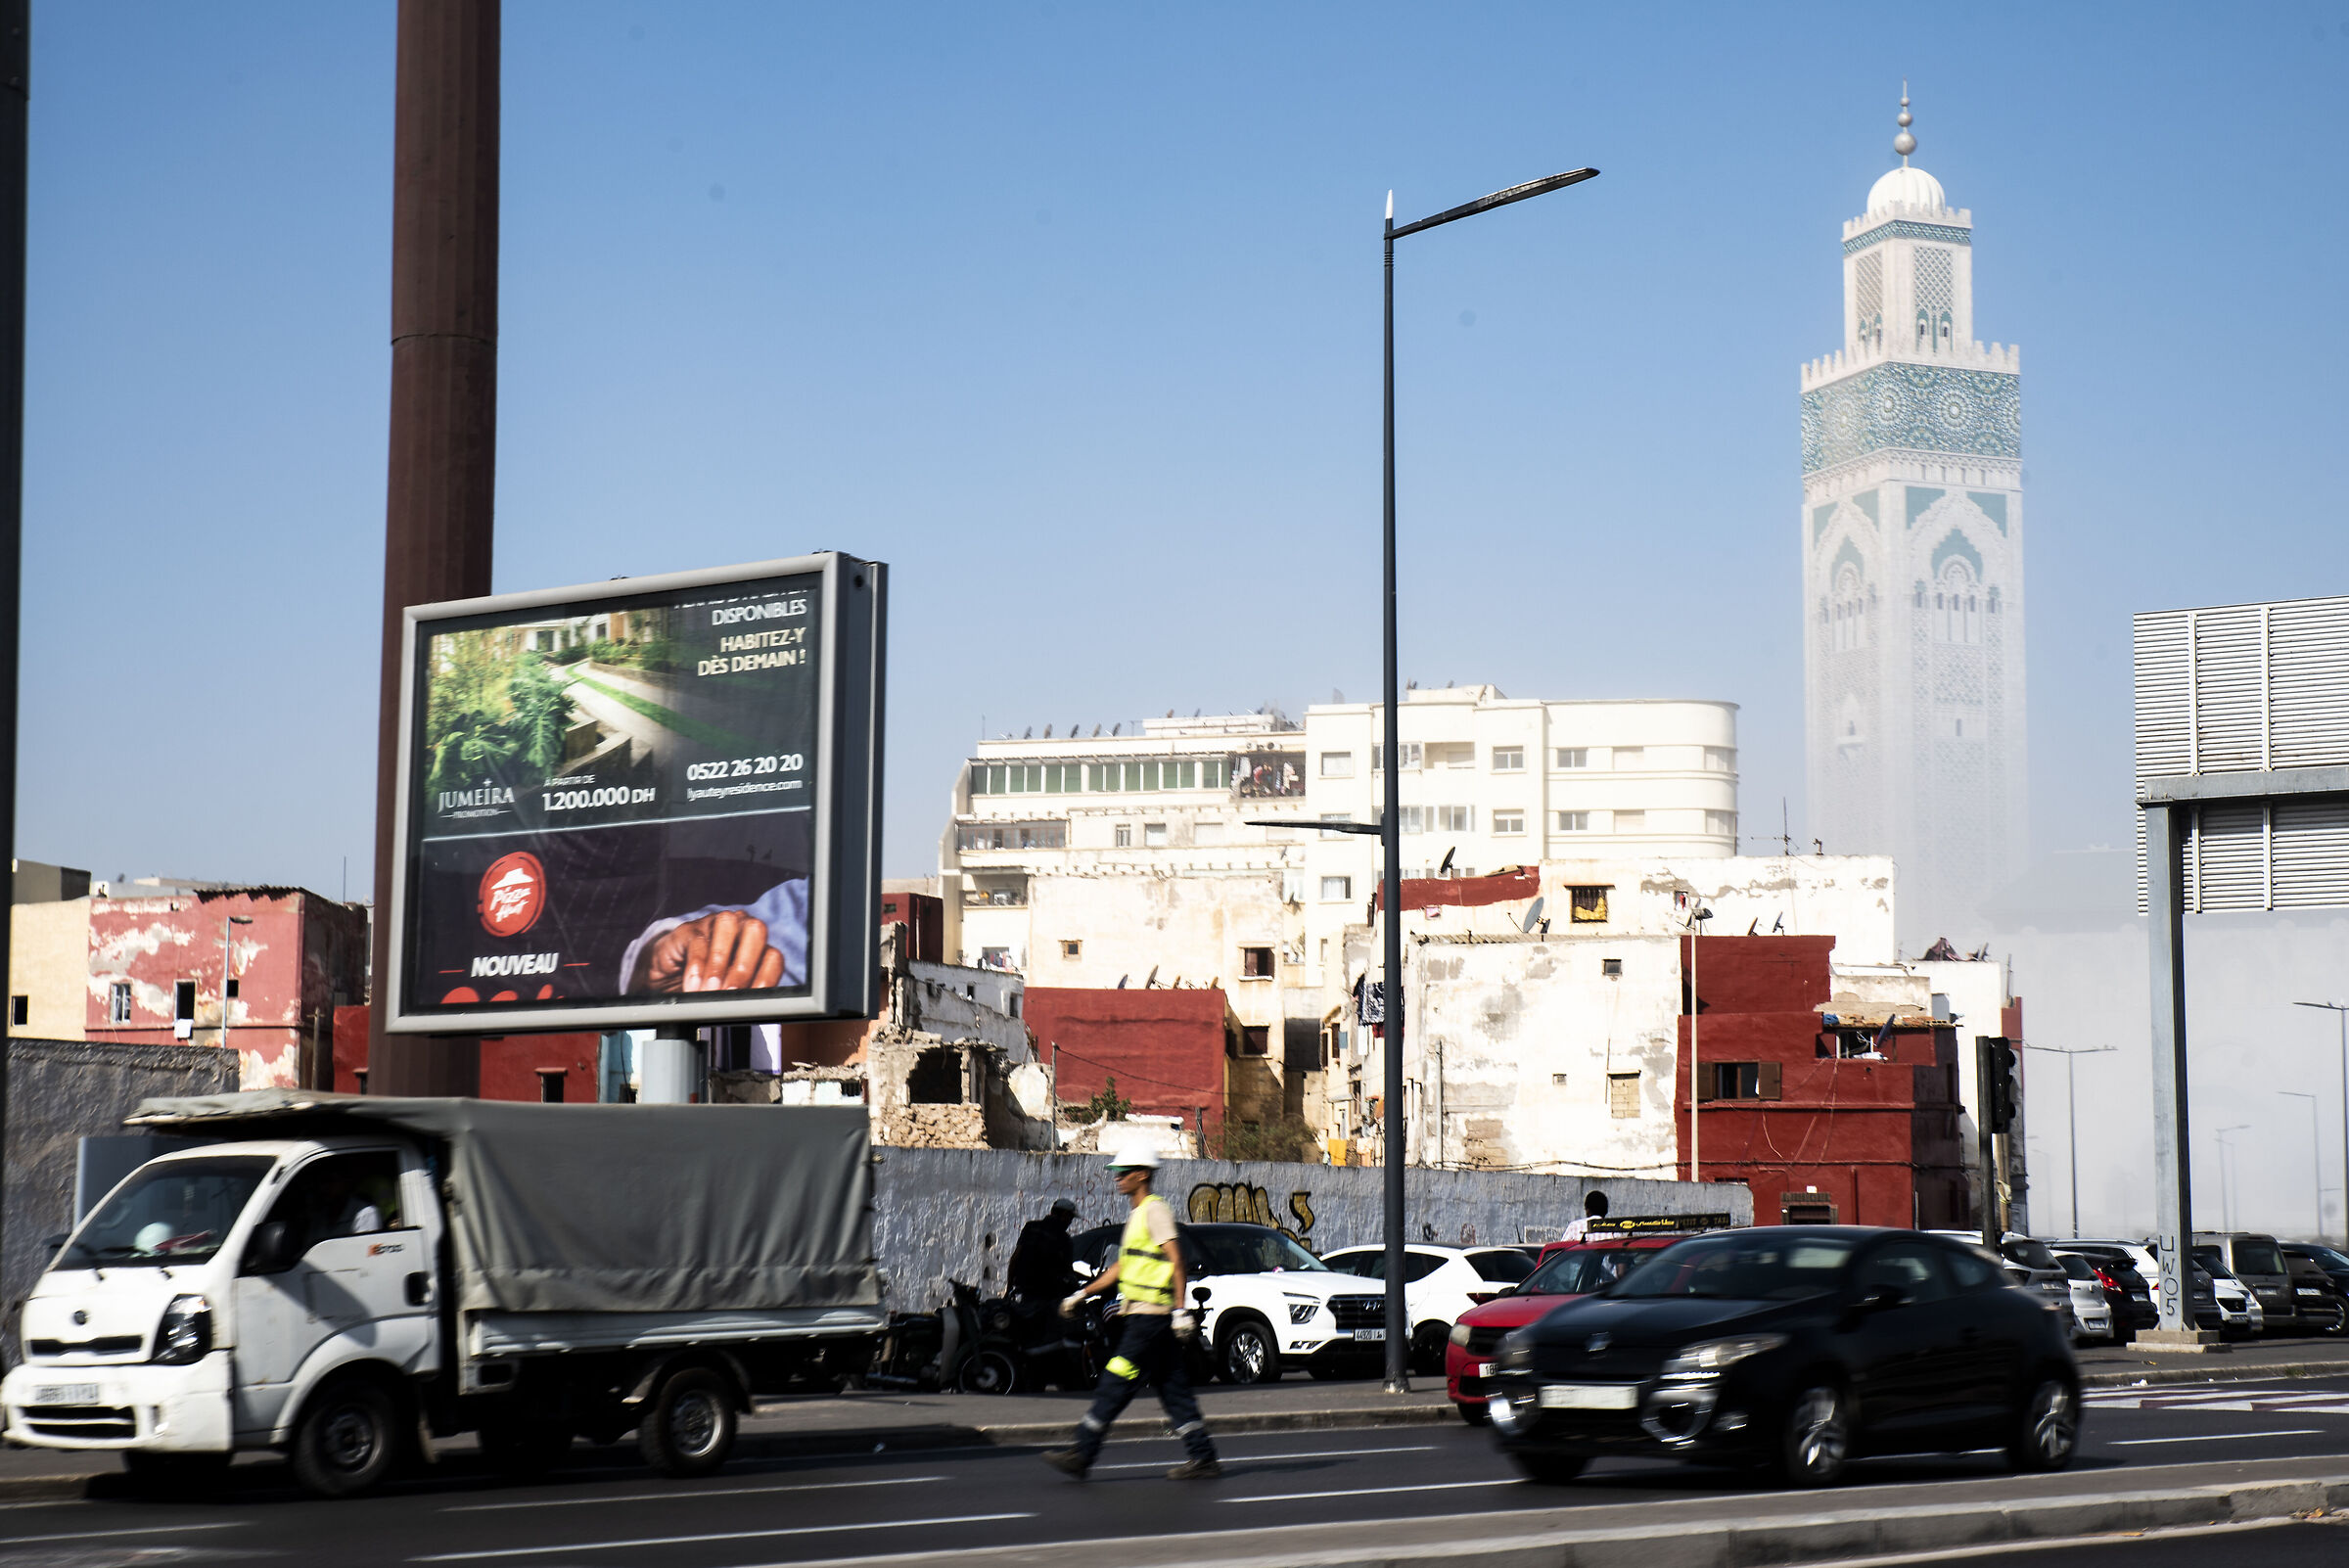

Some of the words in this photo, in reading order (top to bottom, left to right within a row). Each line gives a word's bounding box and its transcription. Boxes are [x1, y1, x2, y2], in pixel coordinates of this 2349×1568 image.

[712, 599, 807, 625] DISPONIBLES
[720, 626, 806, 653] HABITEZ-Y
[697, 655, 728, 676] DÈS
[731, 649, 797, 672] DEMAIN
[686, 761, 729, 780] 0522
[730, 759, 753, 777] 26
[754, 756, 778, 774] 20
[779, 753, 804, 772] 20
[631, 788, 656, 804] DH
[489, 886, 531, 911] Pizza
[494, 899, 530, 923] Hut
[470, 952, 560, 978] NOUVEAU
